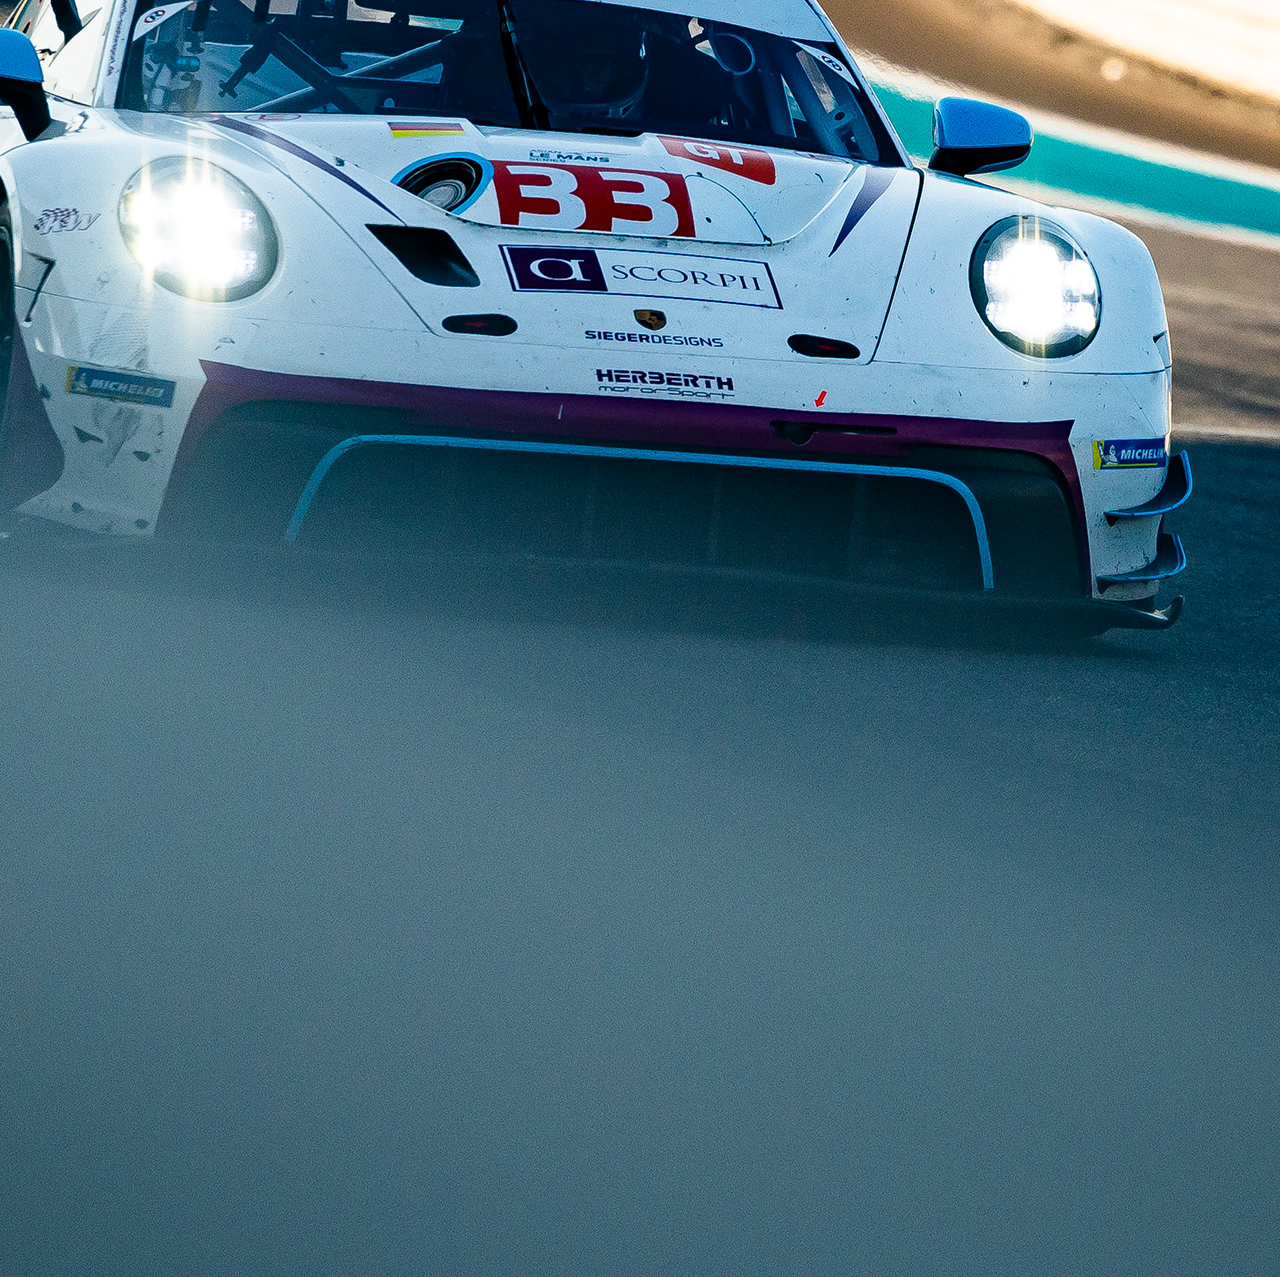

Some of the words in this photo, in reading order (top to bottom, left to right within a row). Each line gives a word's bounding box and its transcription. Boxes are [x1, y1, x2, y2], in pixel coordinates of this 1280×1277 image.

[557, 154, 610, 163] MANS
[683, 141, 749, 165] GT
[506, 164, 680, 239] 33
[610, 263, 765, 292] SCORPII
[584, 330, 724, 348] SIEGERDESIGNS
[595, 368, 734, 391] HERBERTH
[1120, 448, 1164, 460] MICHELIN
